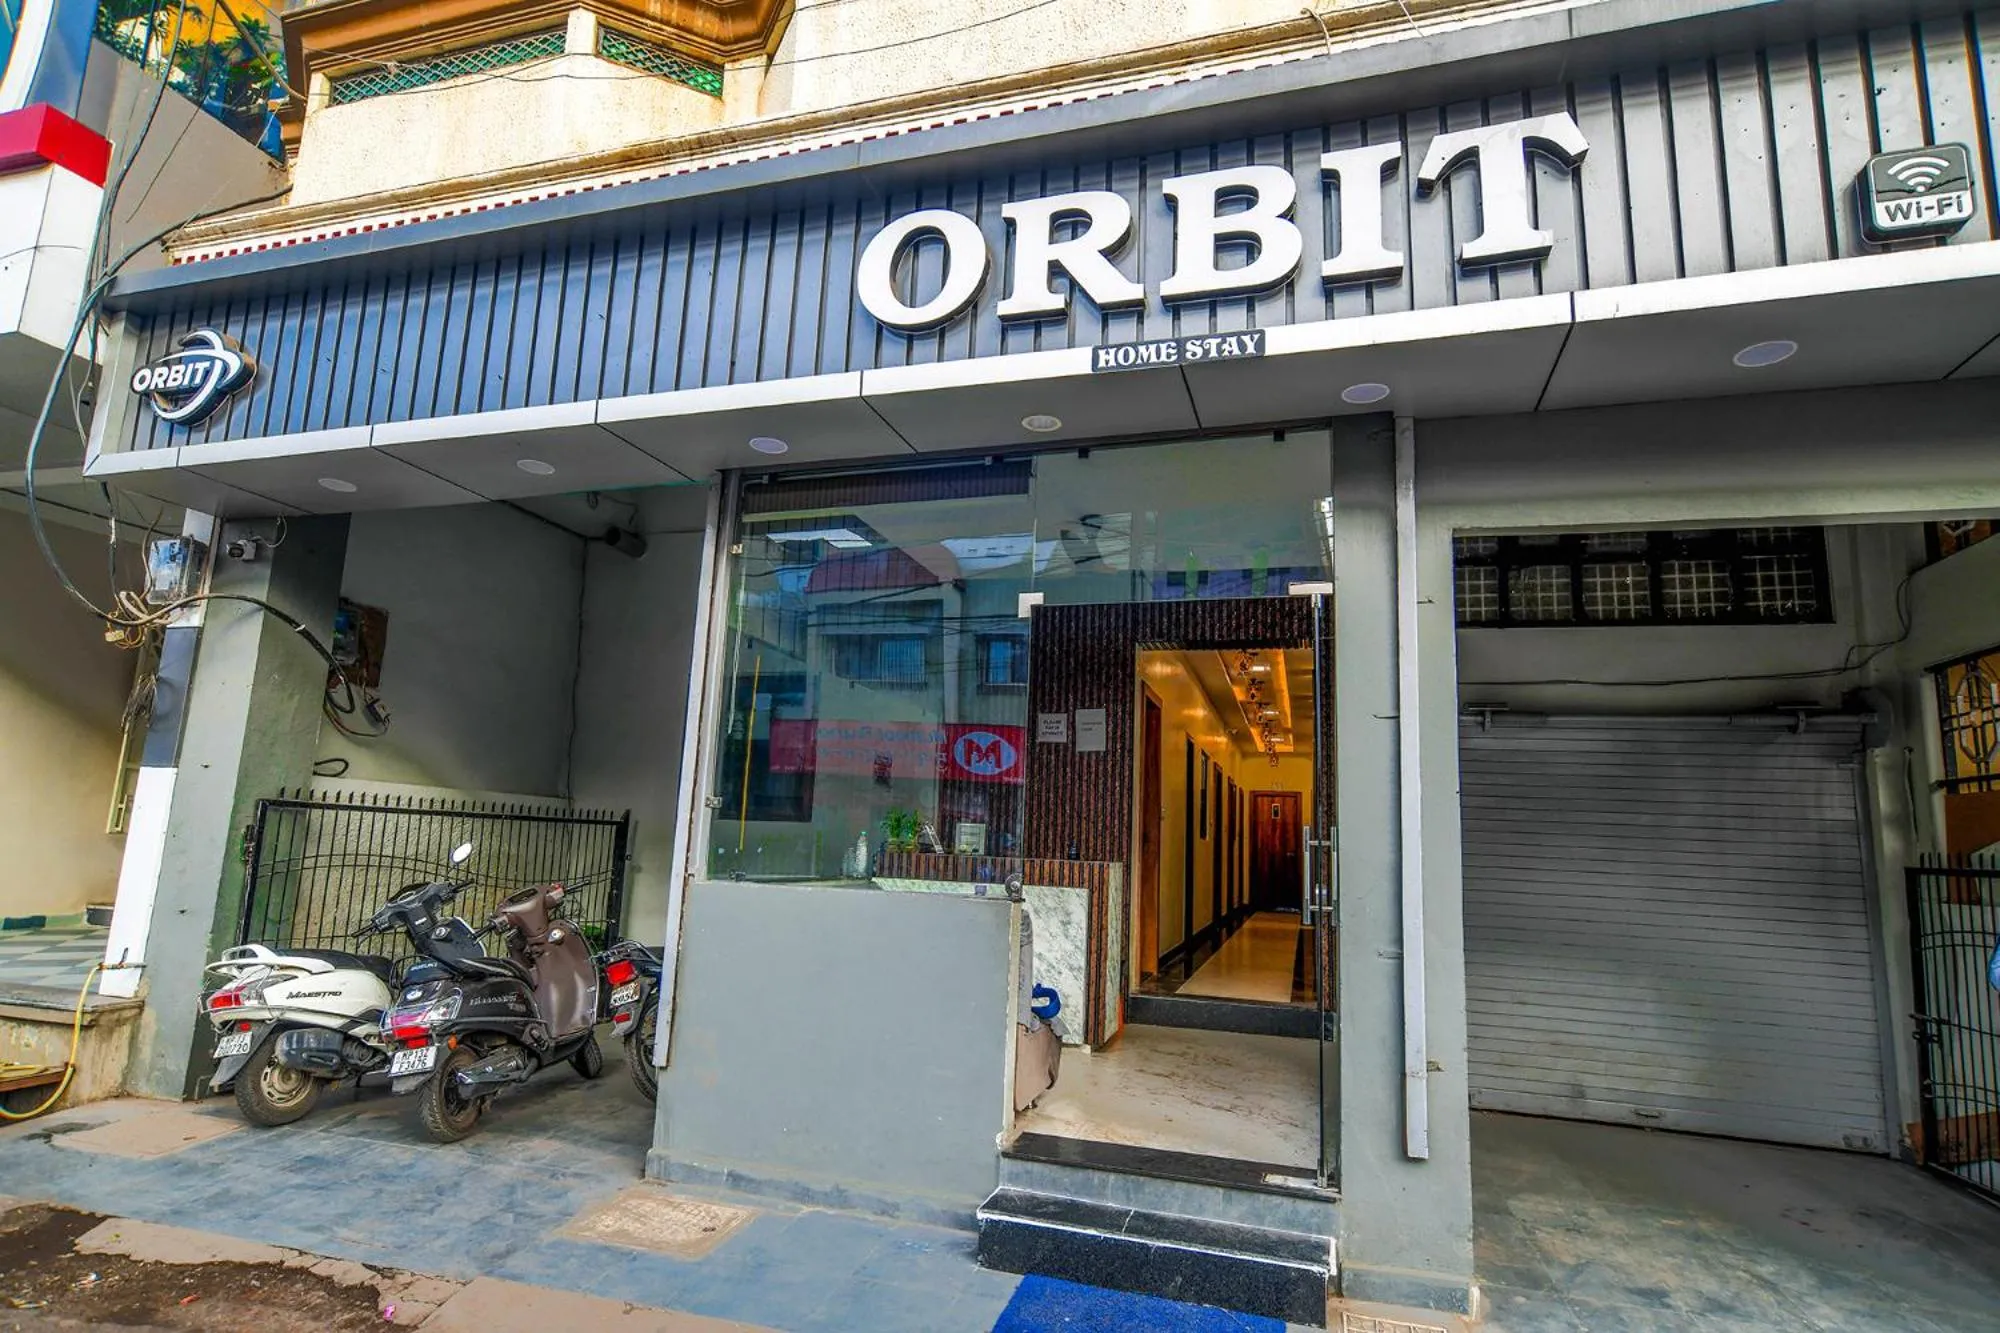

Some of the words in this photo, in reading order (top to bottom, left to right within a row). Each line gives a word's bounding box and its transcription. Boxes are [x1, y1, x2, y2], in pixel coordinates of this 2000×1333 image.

[857, 111, 1589, 330] ORBIT
[1885, 195, 1963, 222] Wi-Fi
[1097, 341, 1179, 368] HOME
[1185, 333, 1261, 360] STAY
[132, 361, 212, 392] ORBIT
